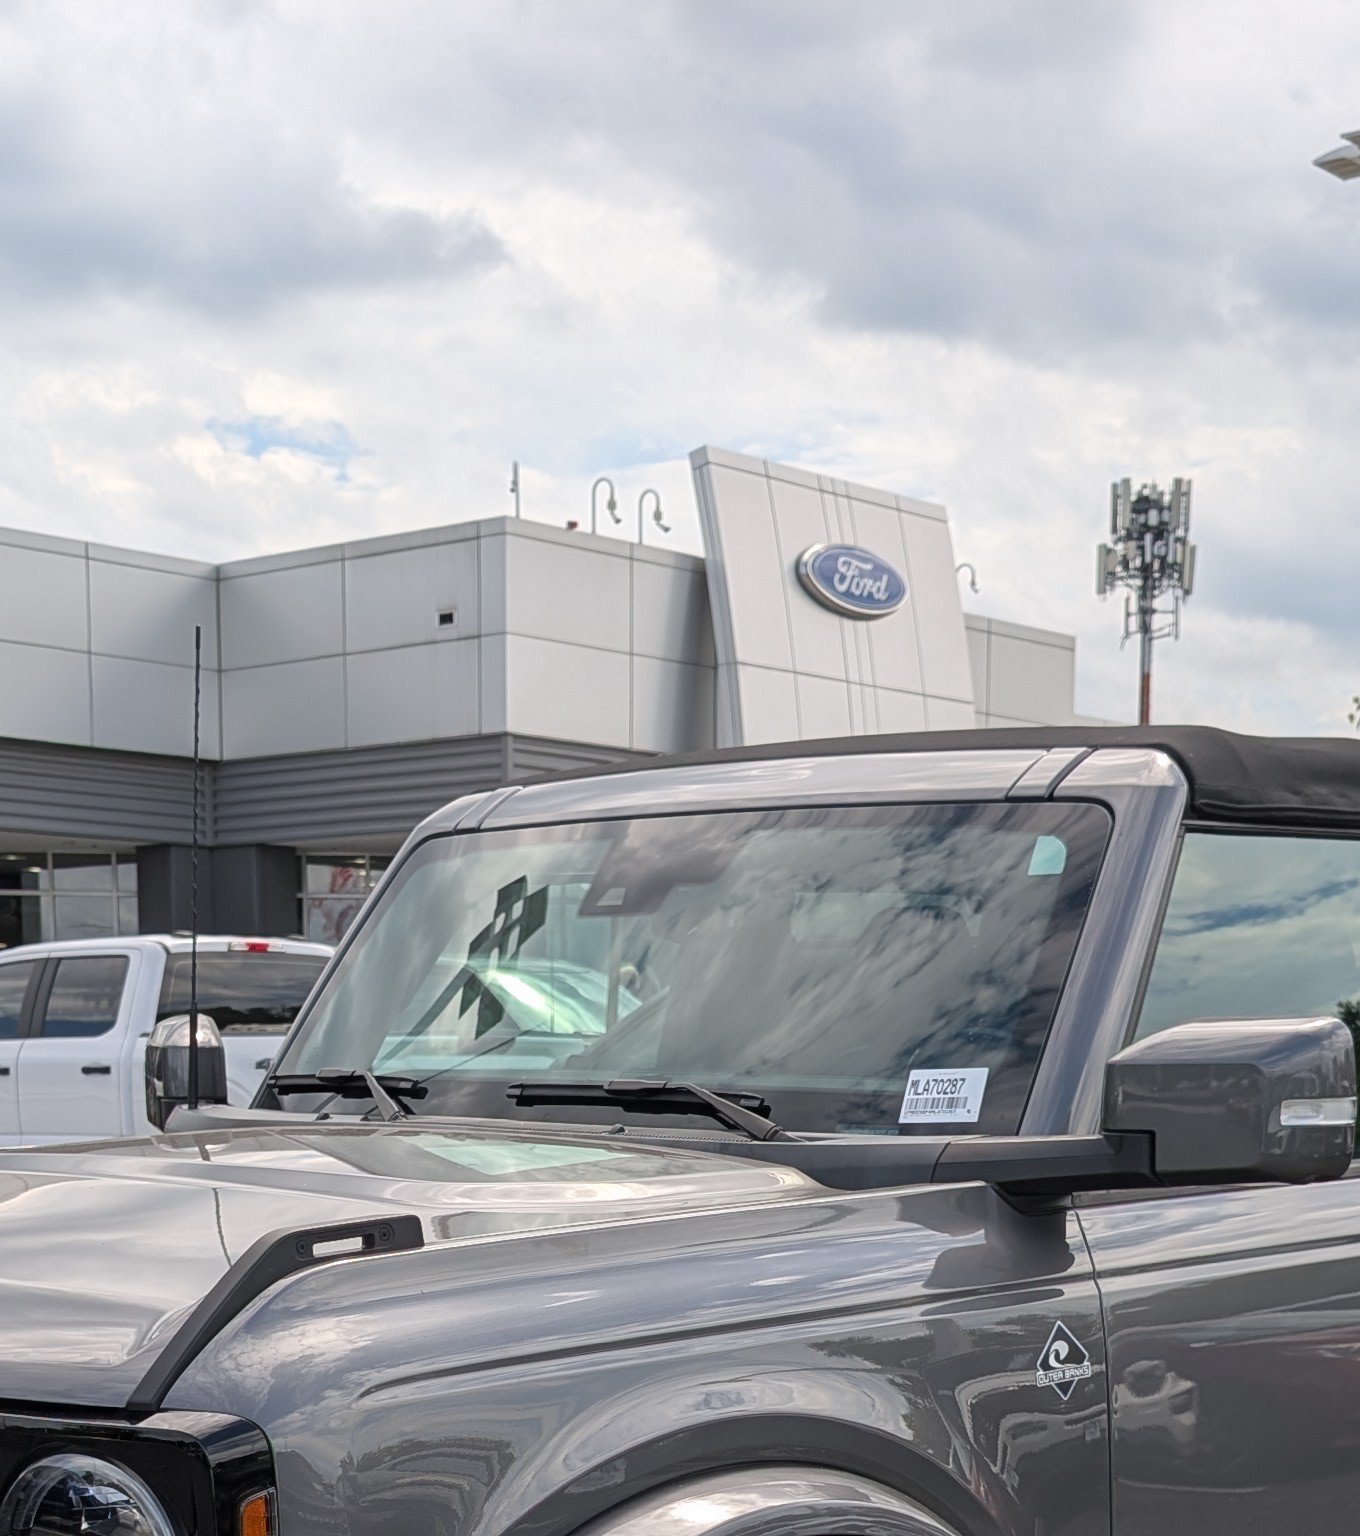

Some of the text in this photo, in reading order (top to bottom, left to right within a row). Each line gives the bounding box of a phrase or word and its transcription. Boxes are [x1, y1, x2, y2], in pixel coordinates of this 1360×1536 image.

[833, 556, 890, 601] Ford
[907, 1077, 967, 1097] MLA70287
[1039, 1366, 1089, 1385] OUTER BANKS
